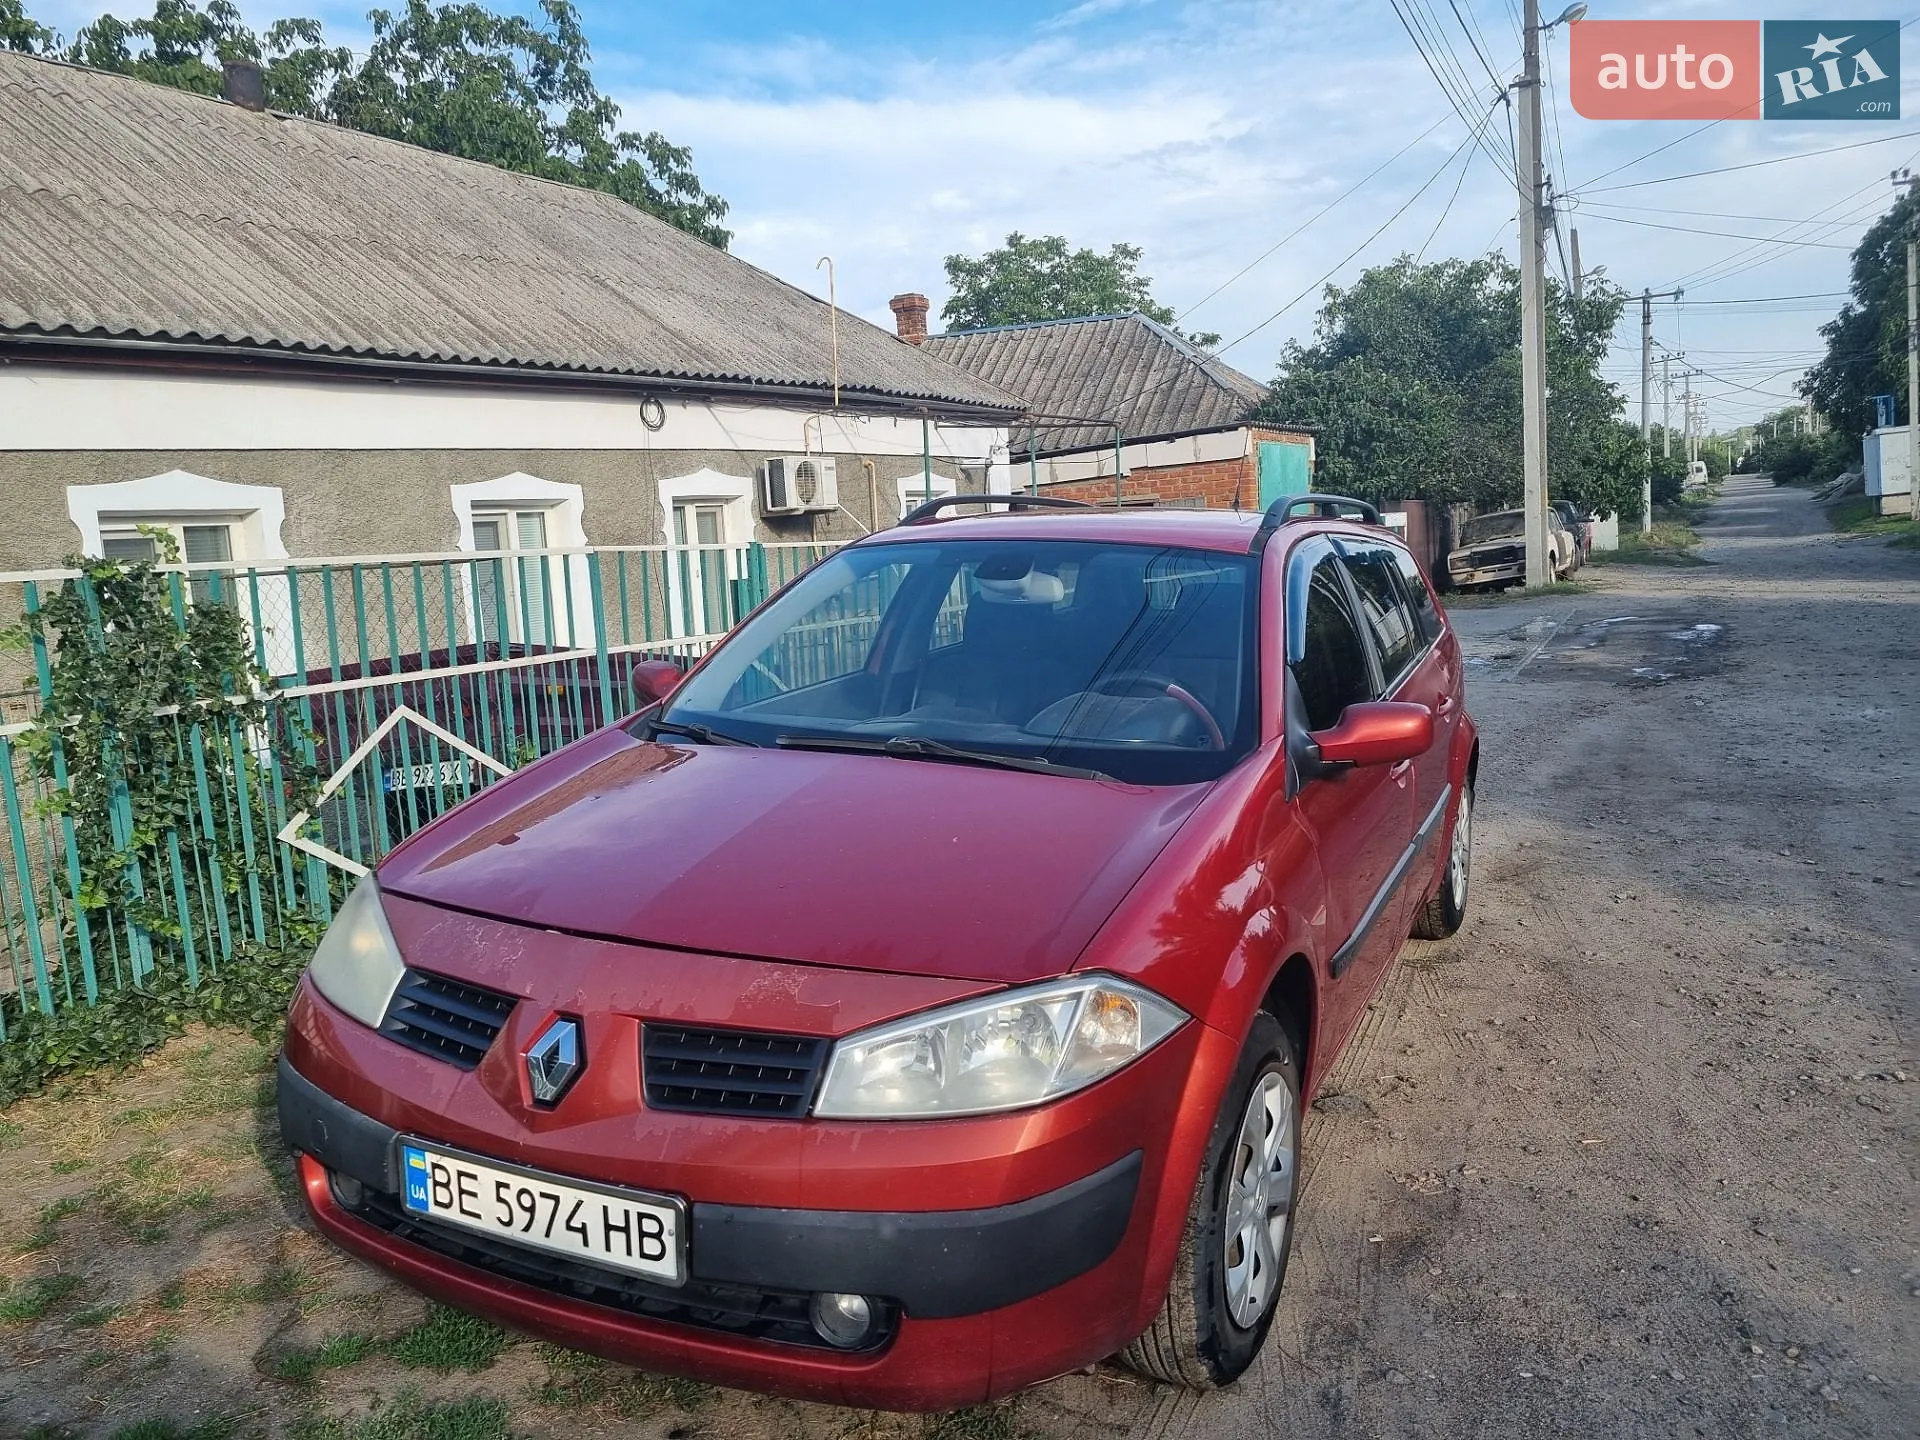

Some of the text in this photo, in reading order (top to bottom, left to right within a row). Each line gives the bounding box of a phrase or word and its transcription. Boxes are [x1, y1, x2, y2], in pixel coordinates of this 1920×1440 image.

[410, 1183, 427, 1202] UA
[430, 1161, 667, 1262] BE 5974 HB
